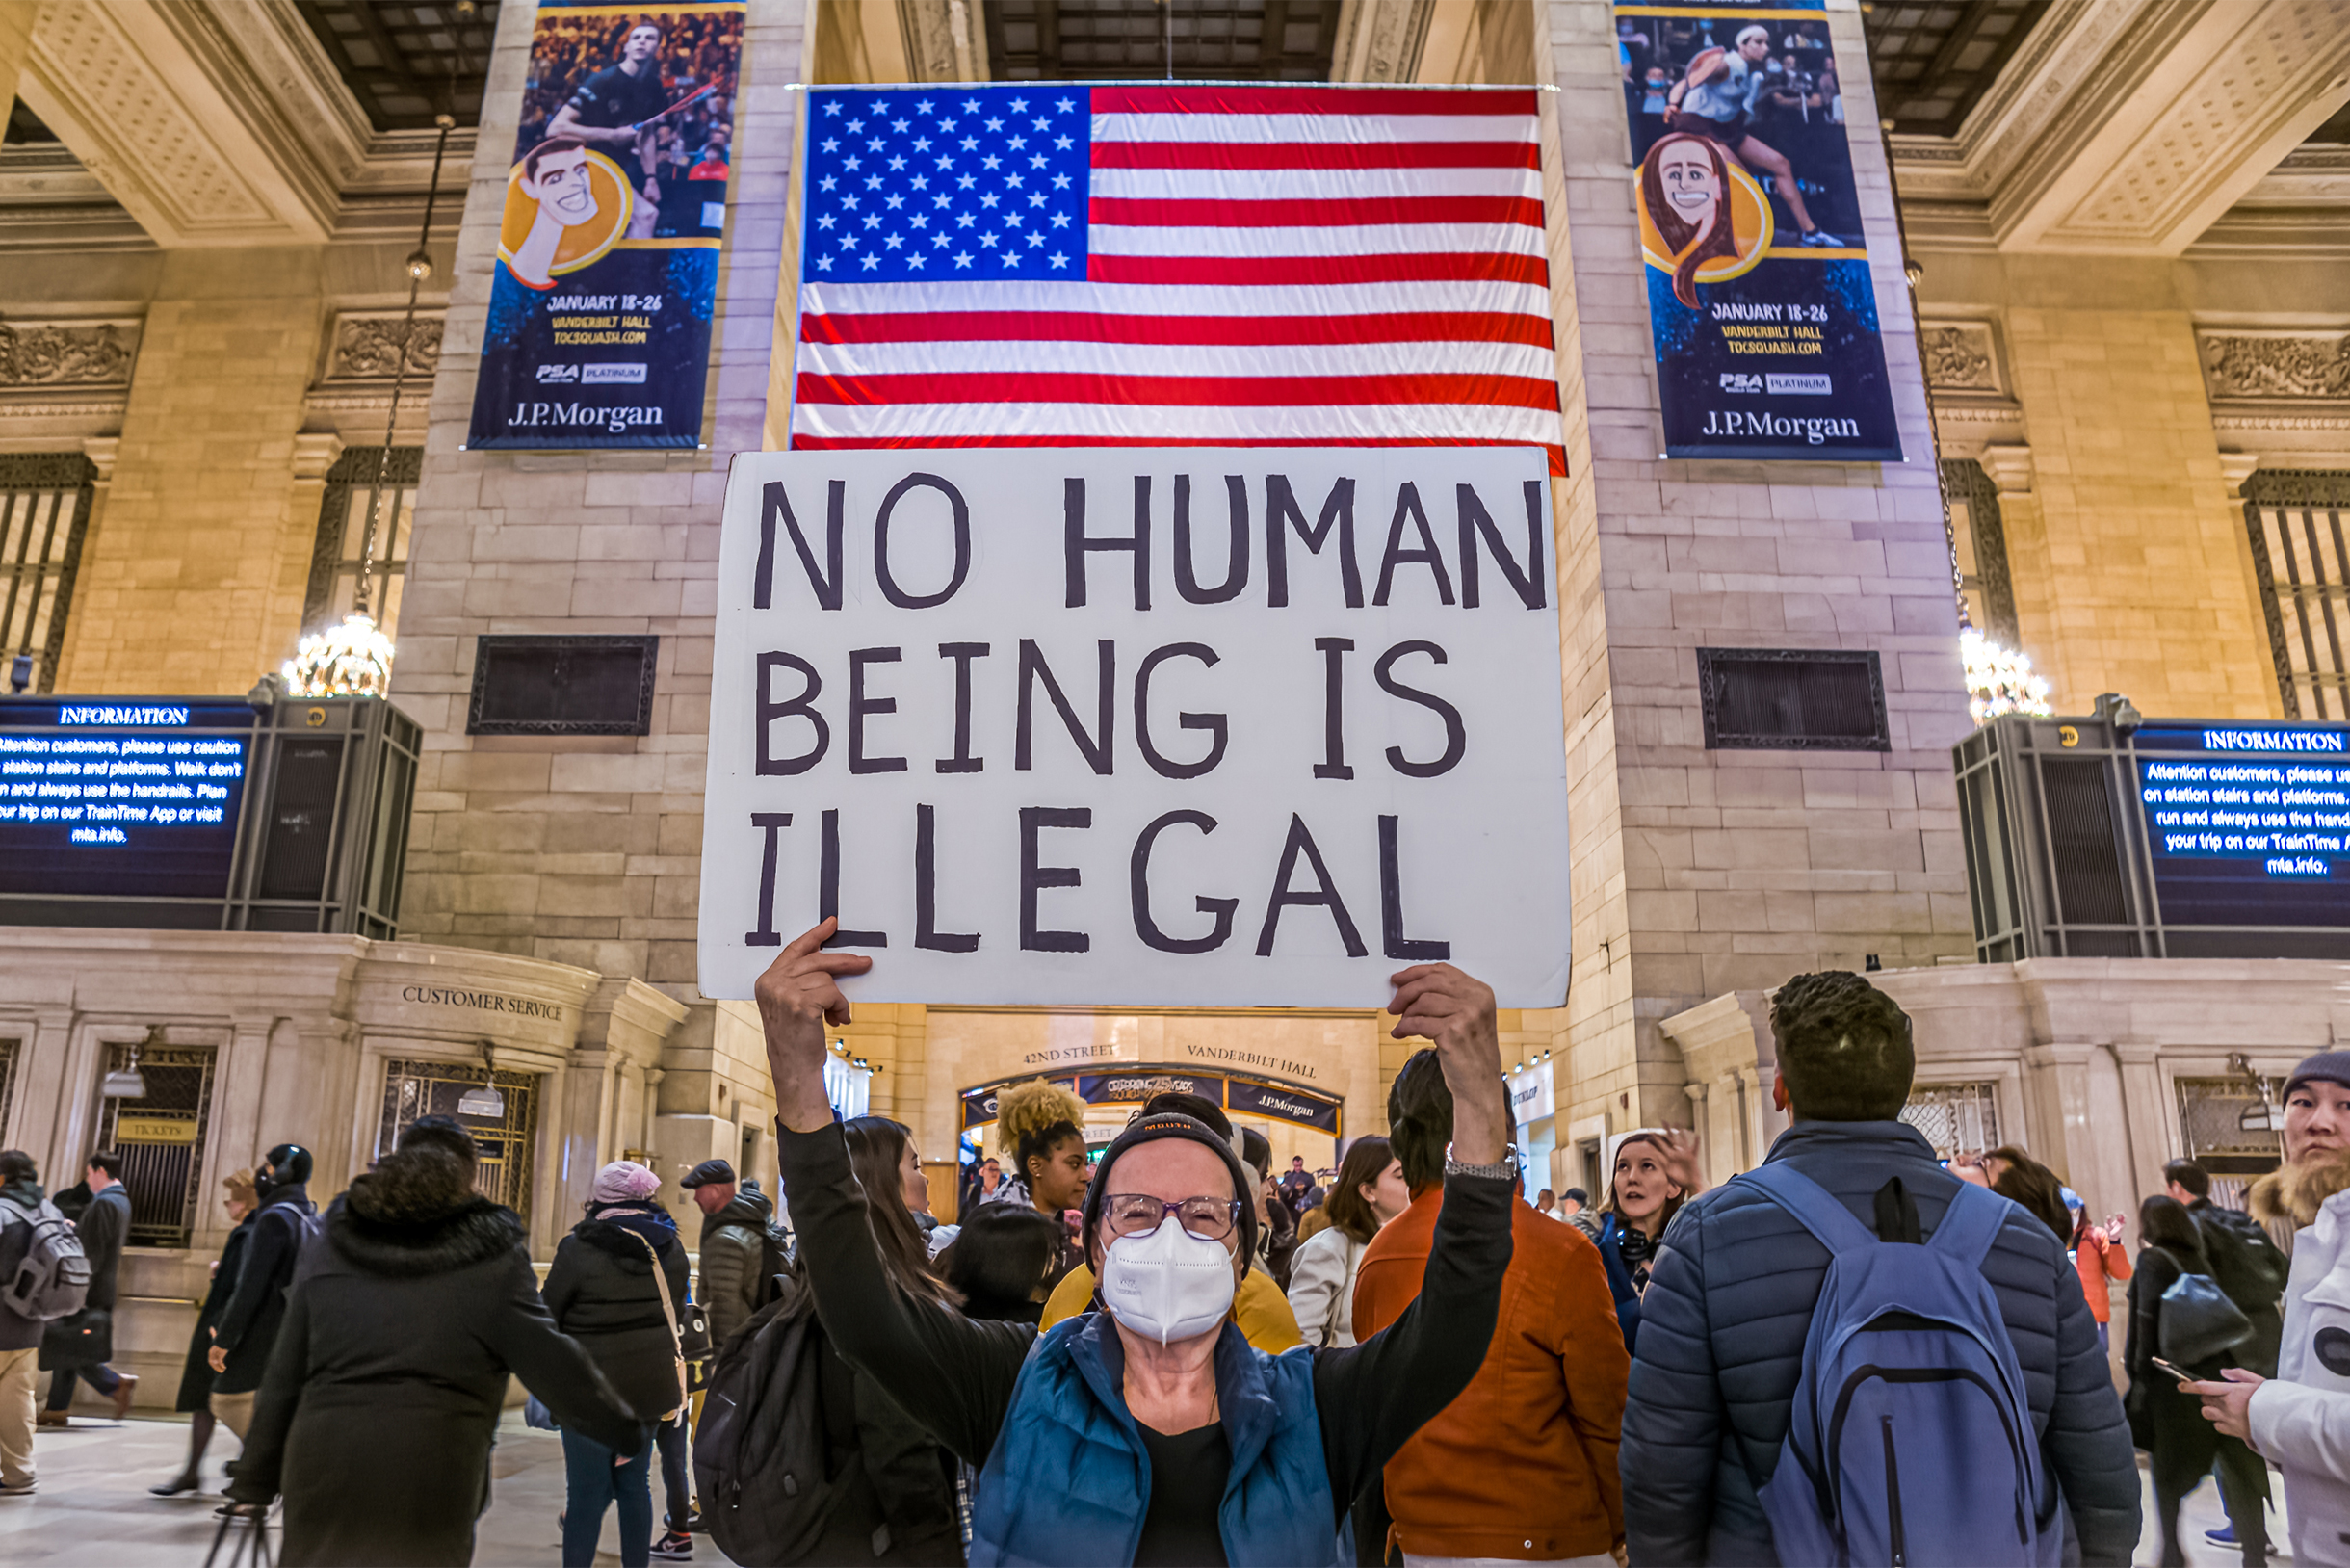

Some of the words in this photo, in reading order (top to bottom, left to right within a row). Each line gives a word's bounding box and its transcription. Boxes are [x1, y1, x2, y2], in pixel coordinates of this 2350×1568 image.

[547, 295, 617, 312] JANUARY
[622, 295, 663, 311] 18-26
[1712, 303, 1782, 321] JANUARY
[1786, 304, 1828, 322] 18-26
[552, 316, 619, 329] VANDERBILT
[622, 316, 652, 329] HALL
[1721, 325, 1790, 339] VANDERBILT
[1793, 326, 1824, 339] HALL
[554, 331, 647, 345] TOCSQUASH.COM
[1728, 341, 1823, 354] TOCSQUASH.COM
[535, 364, 579, 379] PSA
[586, 368, 642, 378] PLATINUM
[1720, 373, 1763, 387] PSA
[1770, 379, 1827, 390] PLATINUM
[508, 402, 663, 433] J.P.Morgan
[1703, 411, 1860, 445] J.P.Morgan
[753, 472, 972, 612] NO
[1063, 474, 1547, 612] HUMAN
[60, 707, 190, 724] INFORMATION
[754, 638, 1229, 777] BEING
[1313, 637, 1467, 781] IS
[51, 739, 119, 755] customers,
[121, 738, 166, 757] please
[167, 742, 191, 755] use
[193, 740, 241, 755] caution
[2204, 731, 2342, 751] INFORMATION
[2, 759, 44, 774] station
[46, 760, 82, 775] stairs
[83, 761, 109, 775] and
[109, 761, 171, 778] platforms.
[175, 761, 208, 776] Walk
[208, 761, 242, 776] don't
[2148, 763, 2207, 781] Attention
[2209, 765, 2285, 784] customers,
[2286, 765, 2333, 785] please
[2336, 769, 2350, 782] us
[10, 781, 37, 797] and
[38, 781, 82, 799] always
[83, 785, 108, 797] use
[110, 782, 131, 797] the
[133, 782, 194, 799] handrails.
[196, 784, 227, 799] Plan
[2144, 788, 2162, 803] on
[2165, 786, 2209, 803] station
[2213, 787, 2250, 803] stairs
[2252, 788, 2279, 804] and
[19, 803, 40, 823] trip
[40, 805, 59, 819] on
[60, 806, 84, 820] our
[86, 803, 148, 821] TrainTime
[150, 805, 177, 823] App
[178, 809, 195, 821] or
[196, 805, 223, 823] visit
[2156, 811, 2180, 826] run
[2182, 809, 2208, 826] and
[2211, 809, 2259, 830] always
[2261, 813, 2286, 827] use
[2289, 811, 2312, 828] the
[2314, 811, 2350, 828] hand
[2166, 834, 2196, 852] your
[2199, 832, 2223, 852] trip
[2225, 836, 2243, 849] on
[2246, 835, 2269, 849] our
[2271, 832, 2340, 851] TrainTime
[744, 803, 1451, 960] ILLEGAL
[403, 986, 505, 1011] CUSTOMER
[509, 998, 562, 1021] SERVICE
[1023, 1050, 1059, 1064] 42ND
[1063, 1044, 1115, 1059] STREET
[1188, 1045, 1278, 1068] VANDERBILT
[1281, 1060, 1317, 1079] HALL
[1258, 1094, 1314, 1117] J.P.Morgan
[1513, 1085, 1538, 1106] DUNLOP
[1084, 1128, 1111, 1139] REET
